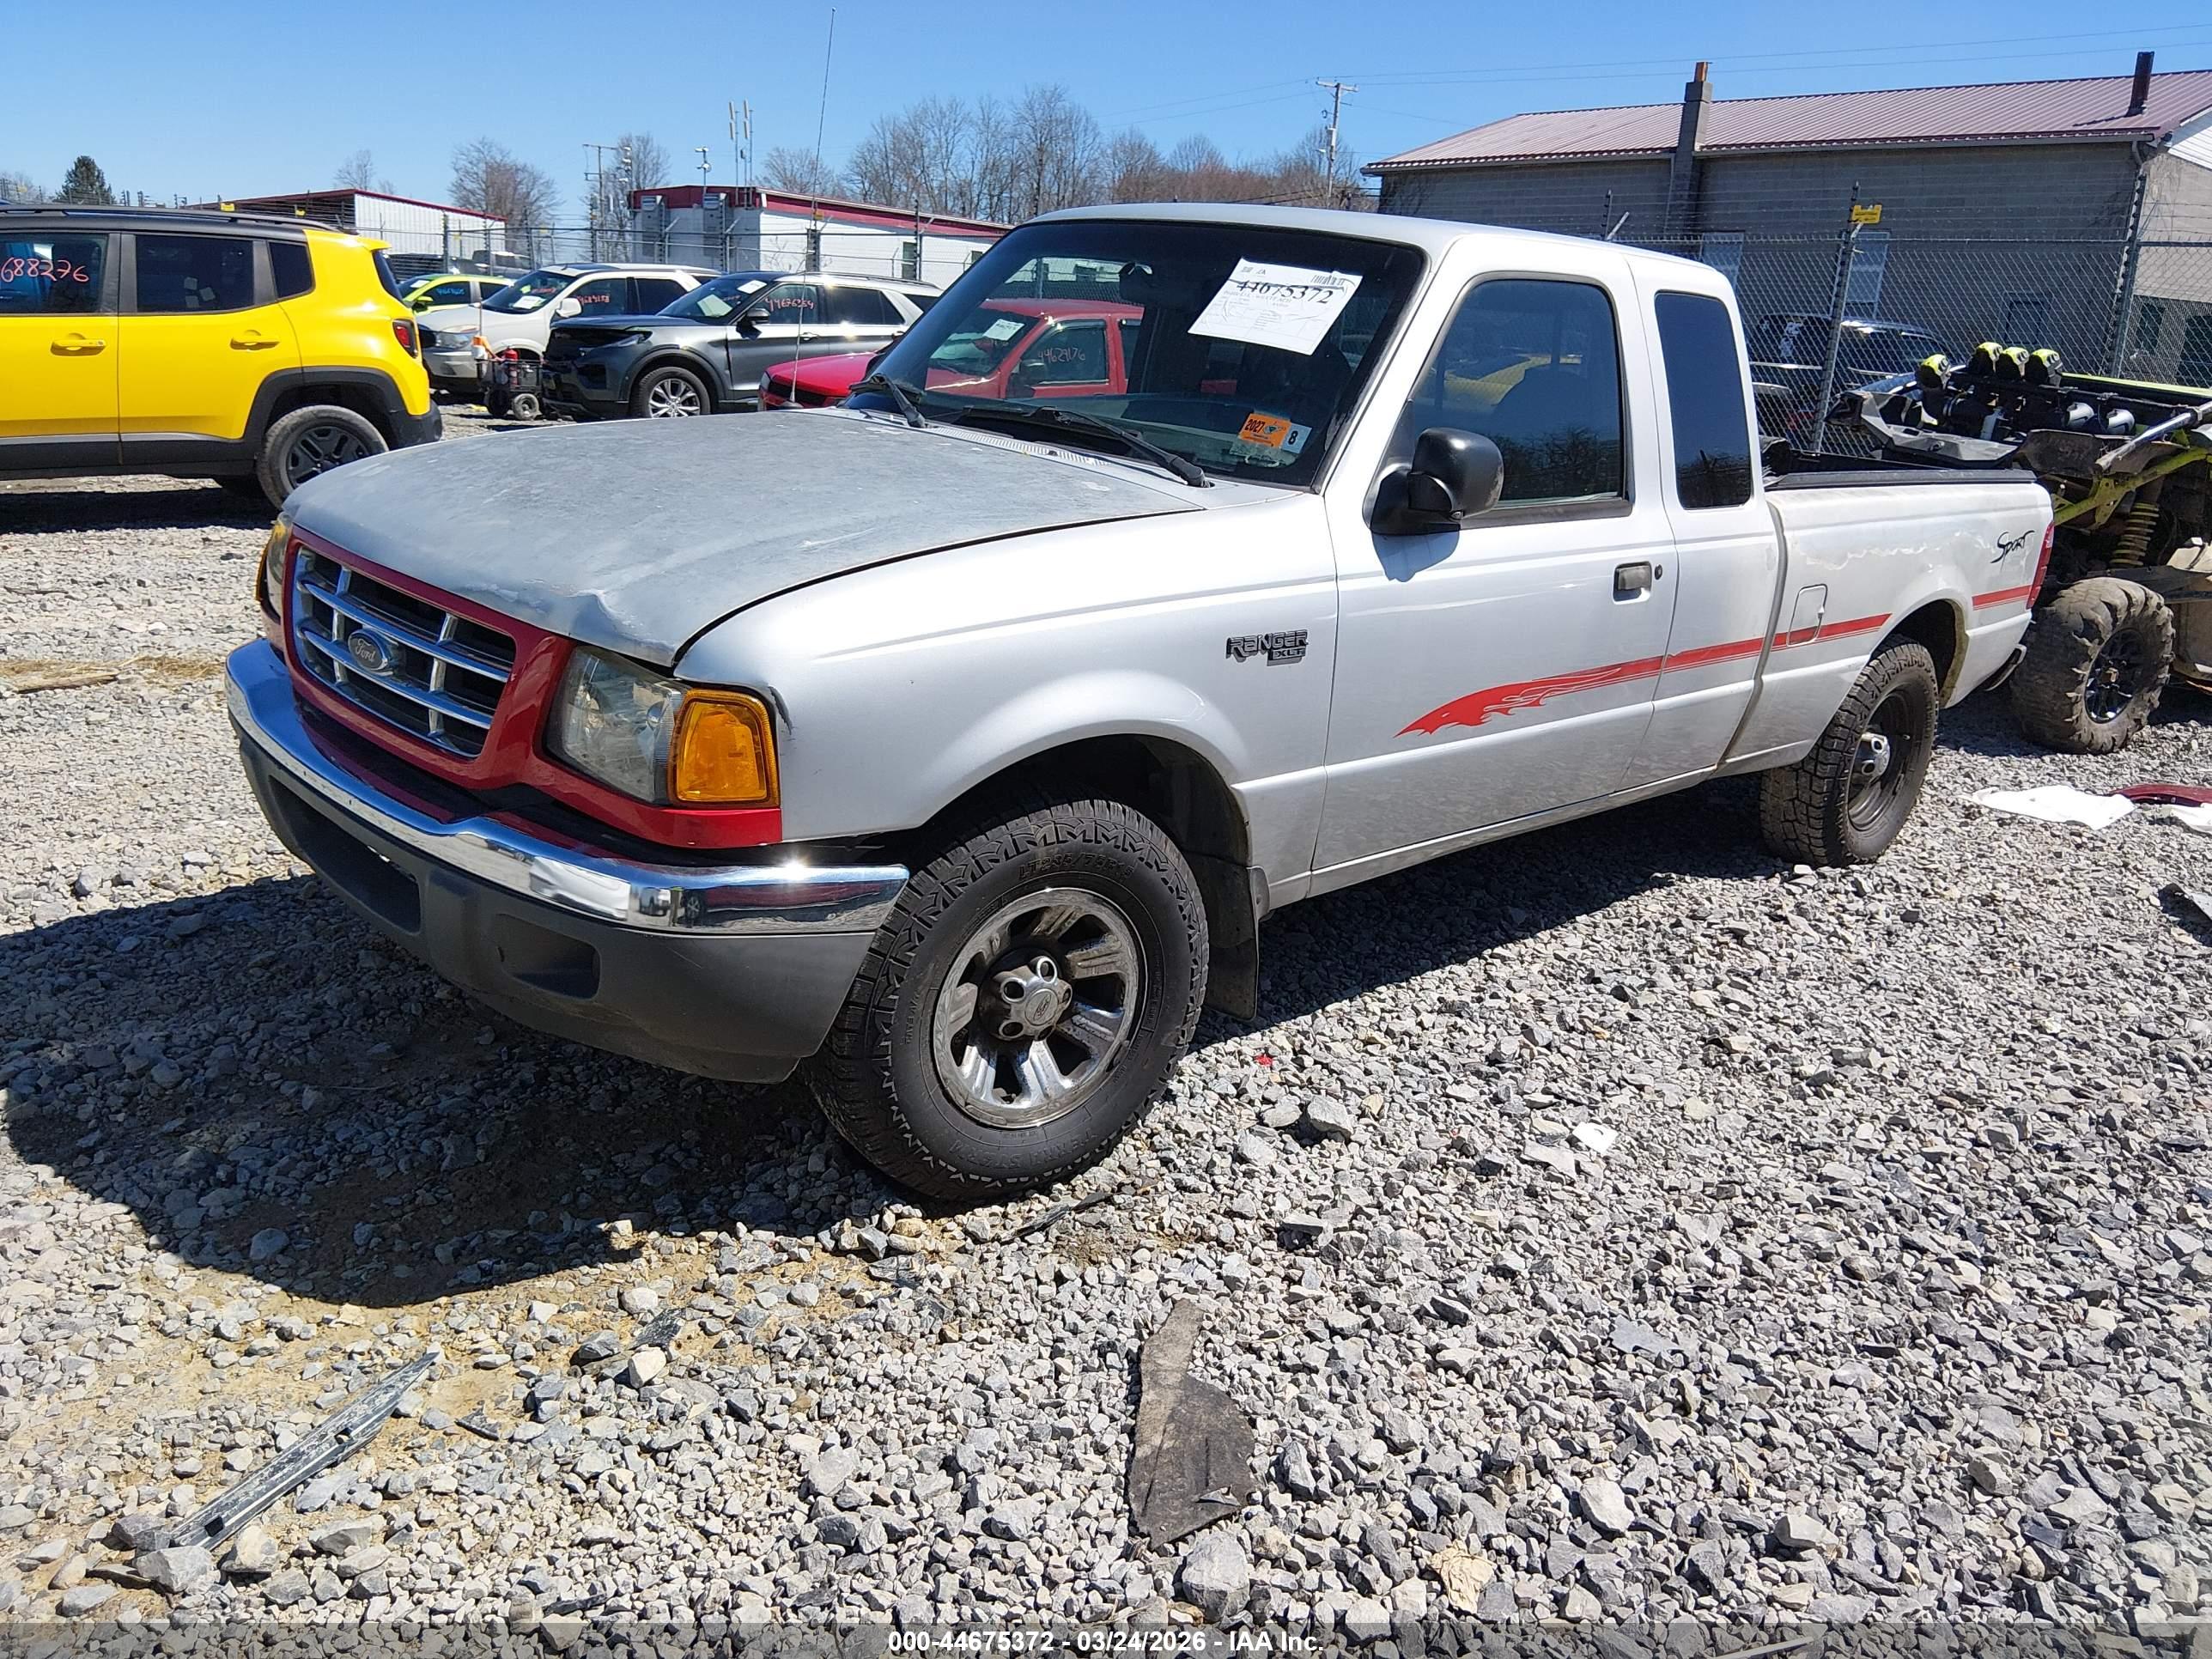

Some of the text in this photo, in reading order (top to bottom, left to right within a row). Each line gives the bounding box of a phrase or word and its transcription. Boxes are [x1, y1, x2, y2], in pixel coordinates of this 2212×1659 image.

[1237, 280, 1334, 304] 44675372
[1244, 418, 1266, 434] 2027
[1288, 430, 1298, 445] 8
[355, 638, 376, 662] Ford
[1225, 629, 1309, 661] RANGER
[1273, 647, 1305, 659] XLT
